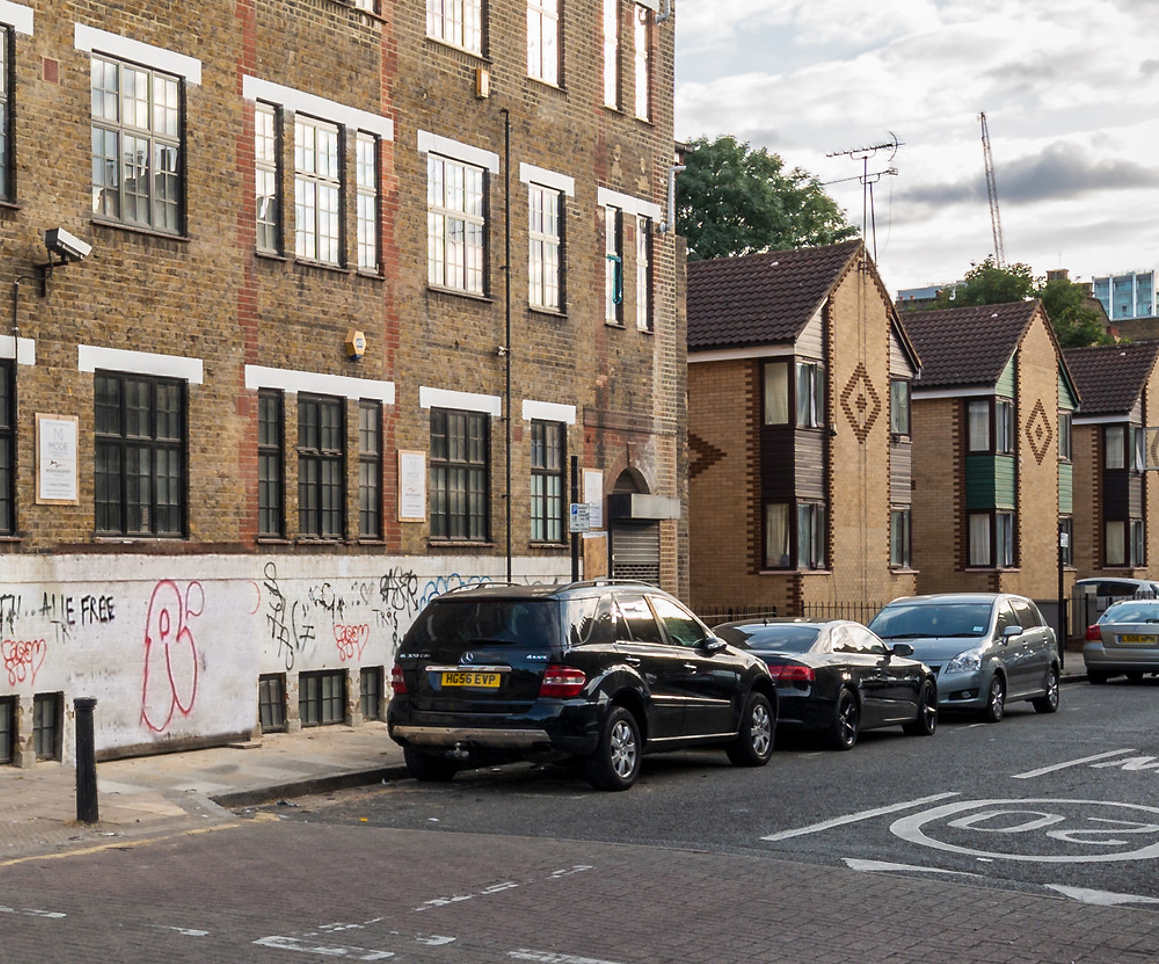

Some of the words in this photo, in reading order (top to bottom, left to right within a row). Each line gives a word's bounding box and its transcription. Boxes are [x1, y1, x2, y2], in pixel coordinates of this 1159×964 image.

[81, 594, 116, 626] FREE
[445, 673, 472, 684] HG56
[474, 674, 496, 685] EVP
